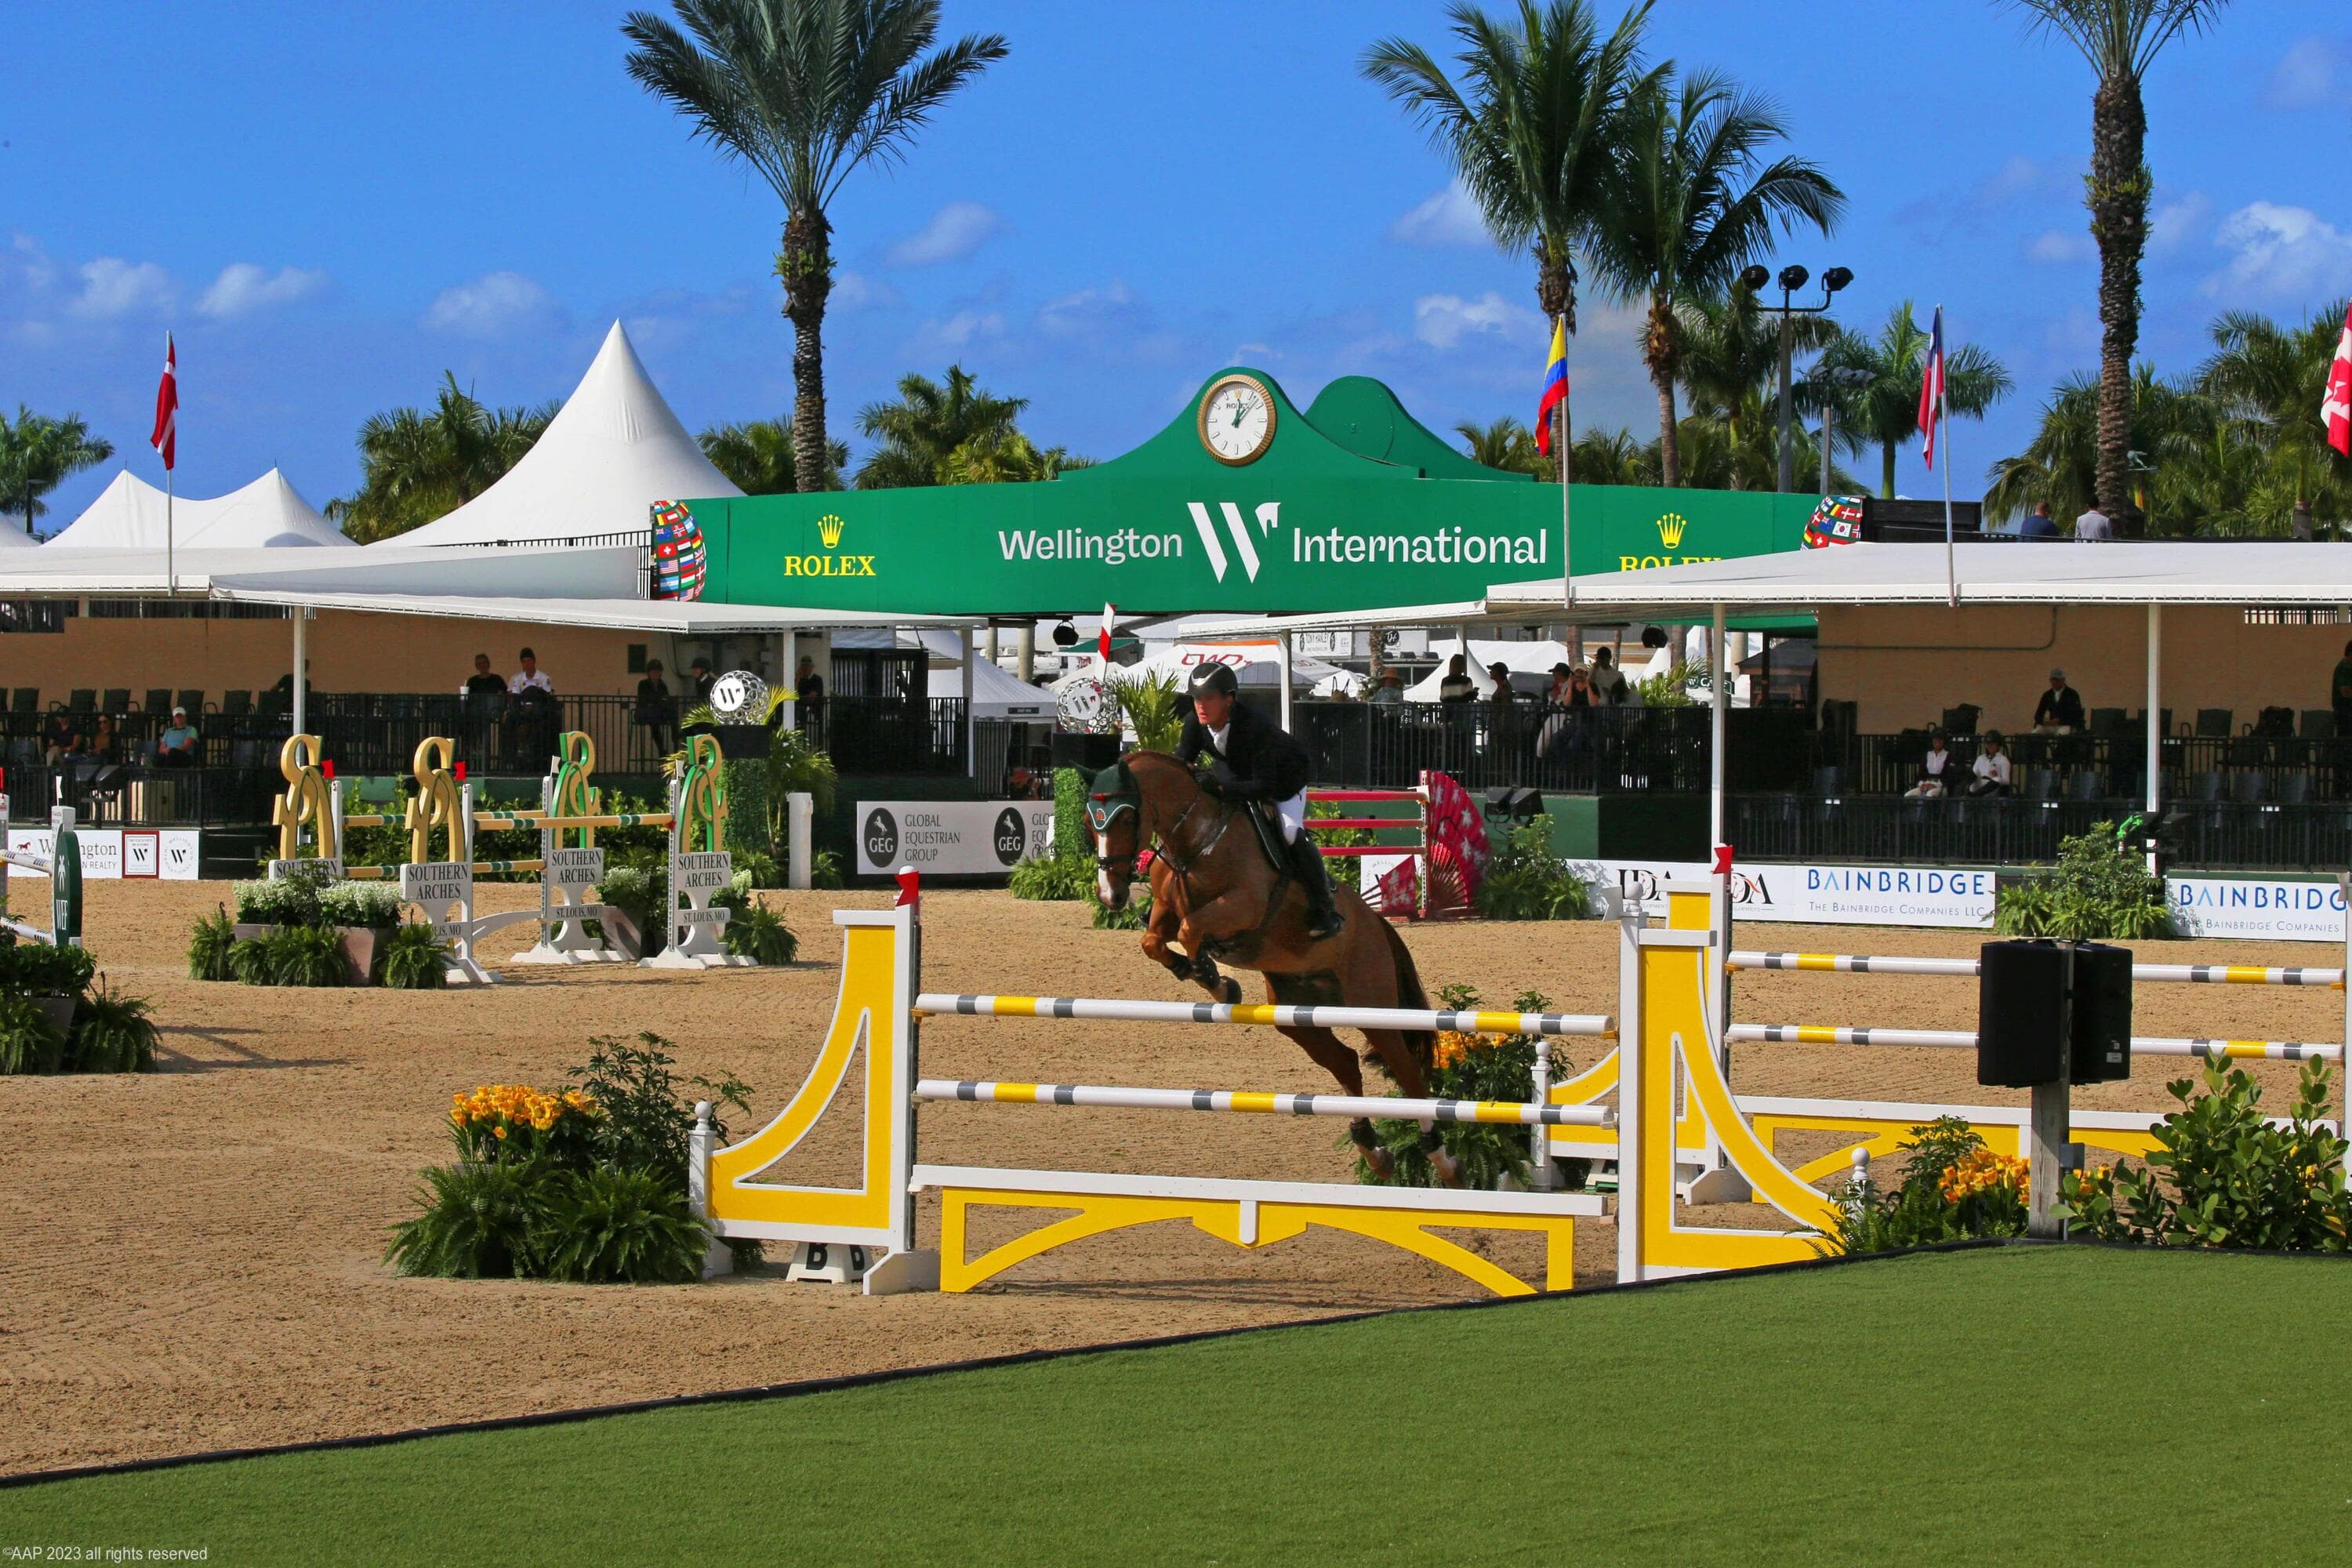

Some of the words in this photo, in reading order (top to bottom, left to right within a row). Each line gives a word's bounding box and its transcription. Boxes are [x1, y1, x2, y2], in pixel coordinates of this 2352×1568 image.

[998, 527, 1182, 564] Wellington
[1294, 526, 1547, 564] International
[784, 555, 877, 576] ROLEX
[905, 814, 942, 827] GLOBAL
[869, 837, 894, 853] GEG
[905, 832, 960, 845] EQUESTRIAN
[998, 836, 1021, 851] GEG
[552, 851, 602, 866] SOUTHERN
[678, 854, 729, 871] SOUTHERN
[905, 848, 938, 862] GROUP
[90, 861, 117, 869] REALTY
[408, 863, 469, 882] SOUTHERN
[558, 868, 595, 884] ARCHES
[685, 871, 722, 887] ARCHES
[1808, 869, 1985, 895] BAINBRIDGE
[416, 883, 461, 900] ARCHES
[2180, 884, 2347, 911] BAINBRIDG
[56, 899, 68, 931] WEF
[556, 908, 565, 918] ST.
[566, 906, 586, 918] LOUIS,
[587, 906, 597, 916] MO
[684, 913, 693, 923] ST.
[694, 912, 713, 923] LOUIS,
[714, 910, 724, 921] MO
[1965, 906, 1985, 916] LLC
[448, 924, 461, 935] MO
